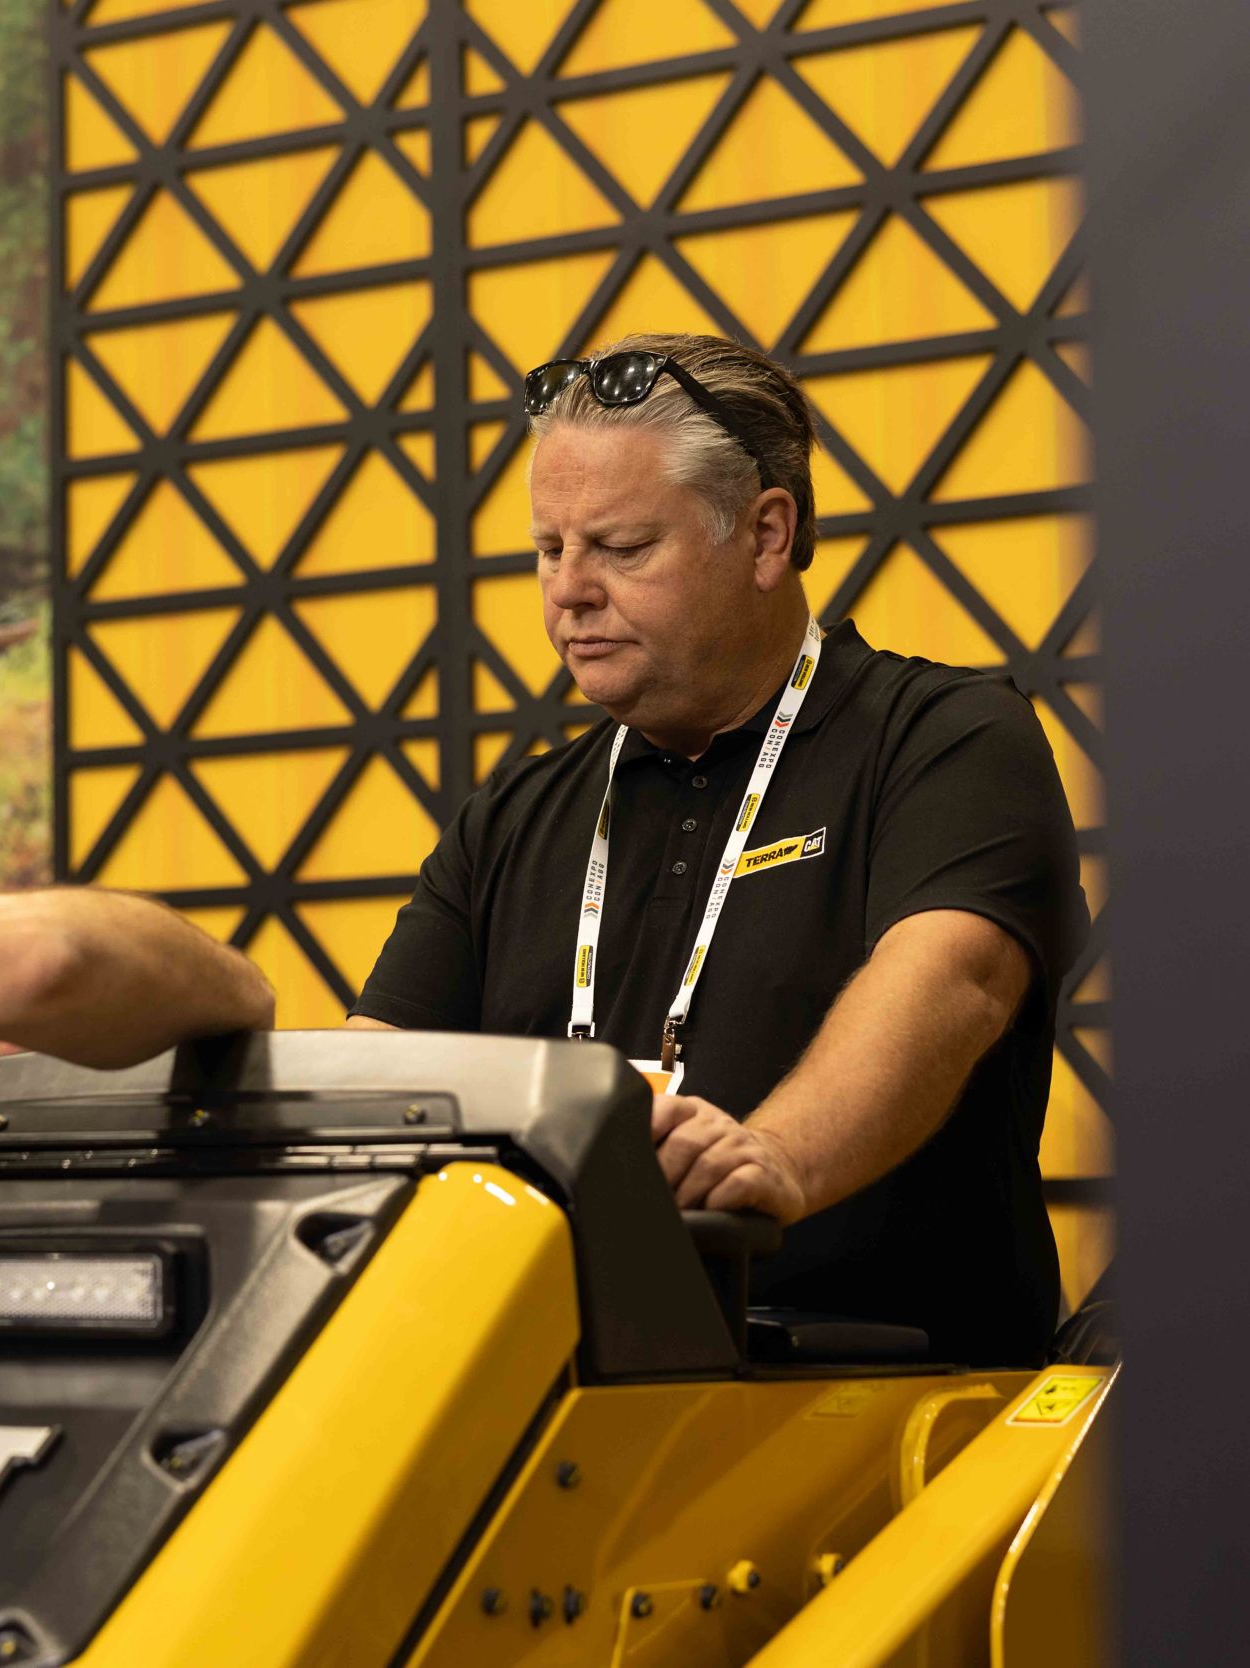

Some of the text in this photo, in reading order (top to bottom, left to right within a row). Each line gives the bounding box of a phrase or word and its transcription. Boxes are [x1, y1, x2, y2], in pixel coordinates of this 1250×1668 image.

[758, 728, 778, 768] CON/AGG
[765, 729, 786, 769] CONEXPO
[745, 836, 823, 868] TERRA CAT
[586, 860, 598, 901] CONEXPO
[594, 863, 605, 902] CON/AGG
[711, 876, 729, 918] CONEXPO
